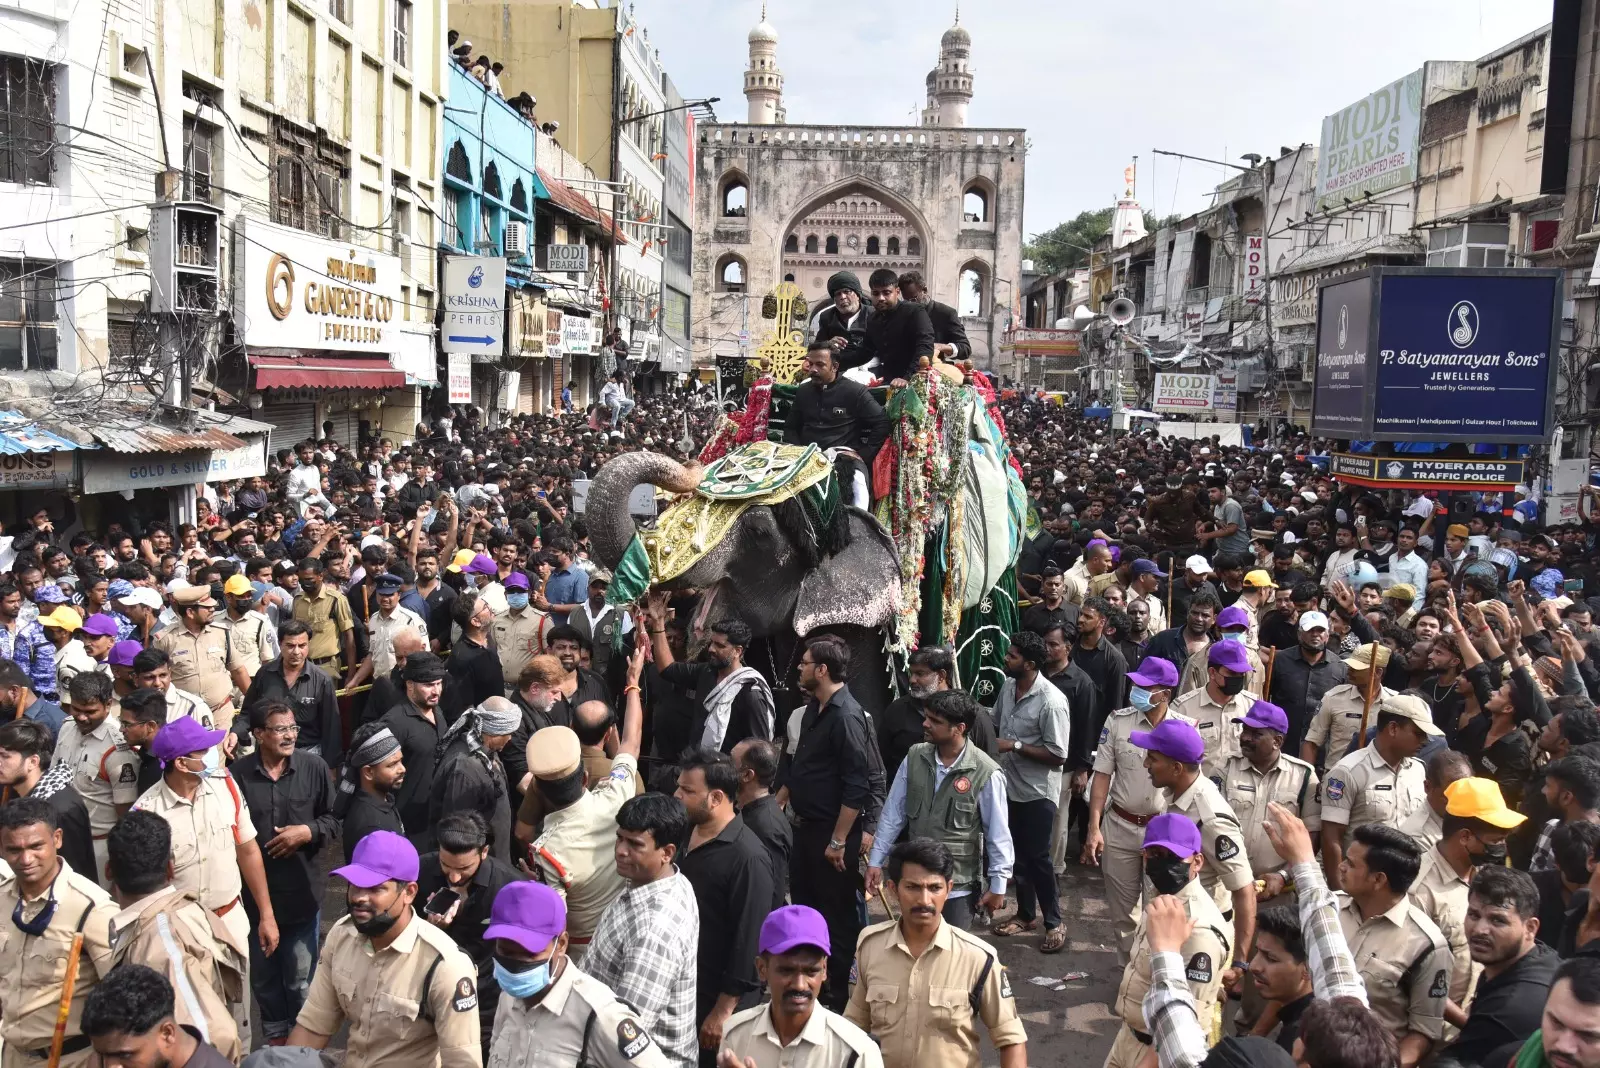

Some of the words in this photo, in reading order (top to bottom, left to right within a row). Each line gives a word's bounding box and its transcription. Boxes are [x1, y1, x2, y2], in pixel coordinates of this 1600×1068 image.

[1329, 80, 1404, 152] MODI
[1326, 126, 1399, 178] PEARLS
[1326, 178, 1338, 191] MAIN
[1349, 168, 1364, 184] SHOP
[1364, 159, 1388, 178] SHIFTED
[1388, 152, 1406, 169] HERE
[550, 246, 584, 260] MODI
[550, 260, 584, 270] PEARLS
[1249, 238, 1262, 289] MODI
[304, 281, 361, 319] GANESH
[375, 295, 393, 323] CO
[451, 313, 495, 326] PEARLS
[1380, 350, 1394, 365] P.
[1398, 350, 1501, 369] Satyanarayan
[1160, 375, 1211, 389] MODI
[1430, 372, 1490, 381] JEWELLERS
[1160, 388, 1210, 399] PEARLS
[1448, 384, 1456, 392] by
[1457, 384, 1496, 392] Generations
[1376, 417, 1416, 425] Machlikaman
[1420, 418, 1461, 426] Mehdipatnam
[0, 453, 52, 470] ONS
[1340, 457, 1370, 467] HYDERABAD
[1412, 461, 1507, 471] HYDERABAD
[129, 465, 164, 479] GOLD
[170, 462, 178, 475] &
[184, 459, 227, 474] SILVER
[1339, 466, 1355, 475] TRAFFIC
[1355, 468, 1370, 476] POLICE
[1412, 471, 1462, 480] TRAFFIC
[1463, 473, 1505, 481] POLICE
[1188, 972, 1209, 982] POLICE
